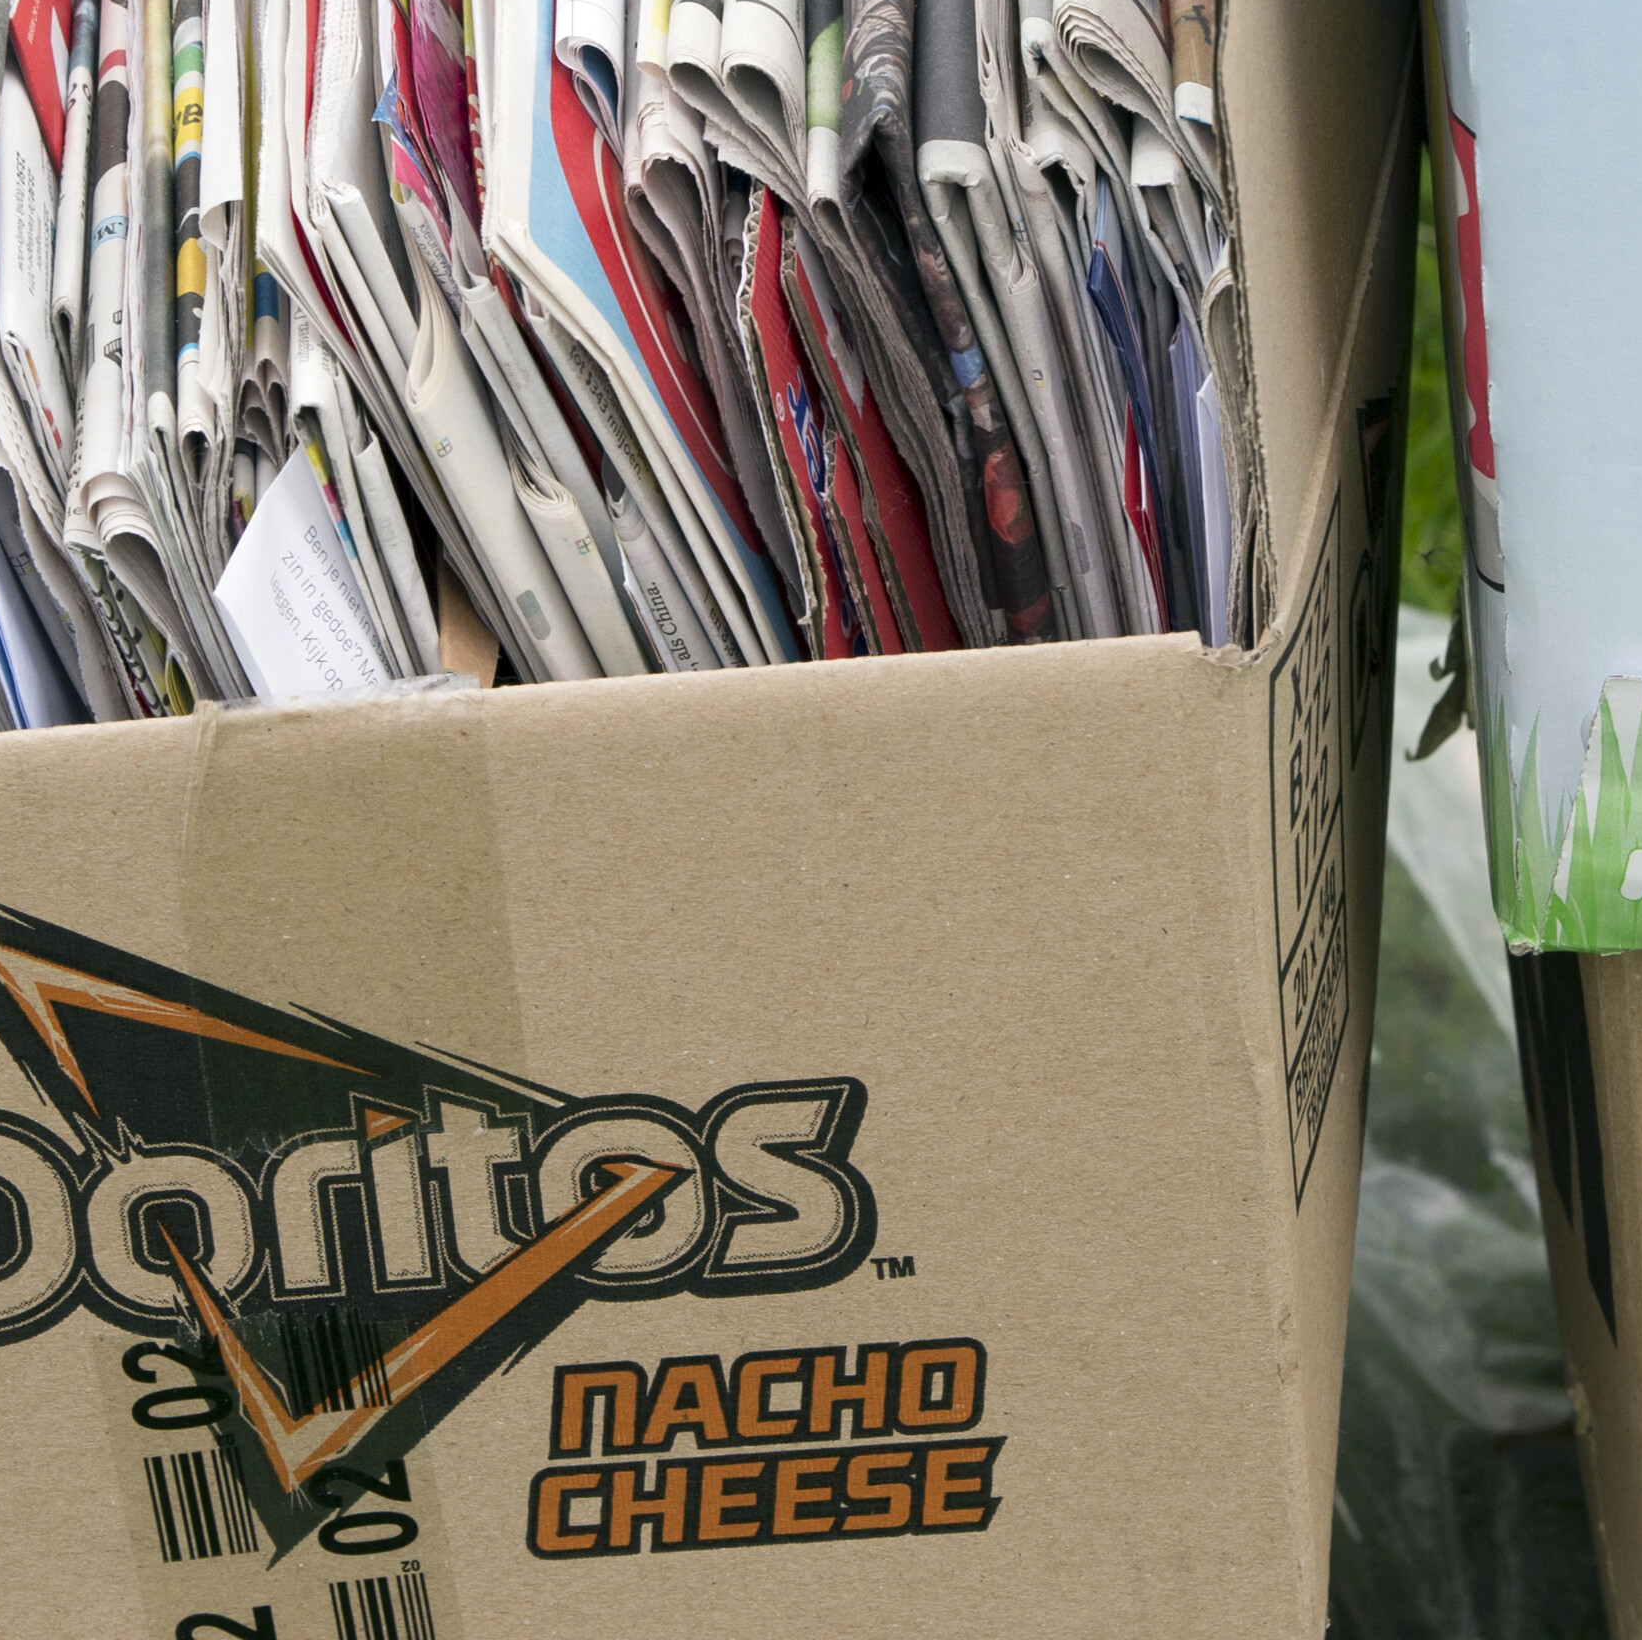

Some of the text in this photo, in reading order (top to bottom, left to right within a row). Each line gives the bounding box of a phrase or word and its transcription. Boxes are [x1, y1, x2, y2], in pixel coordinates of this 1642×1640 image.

[604, 414, 648, 481] miljoen.
[280, 549, 308, 578] zin
[300, 523, 331, 564] Ben
[336, 580, 365, 618] niet
[642, 580, 679, 638] China.
[263, 570, 307, 636] leggen.
[299, 630, 329, 668] Kijk
[1290, 558, 1331, 742] X772
[1289, 645, 1331, 832] B772
[1292, 962, 1309, 1030] 20
[1295, 930, 1345, 1118] BREEKBAAR
[1305, 1020, 1339, 1148] FRAGILE
[549, 1336, 988, 1457] NACHO
[525, 1434, 1008, 1559] CHEESE
